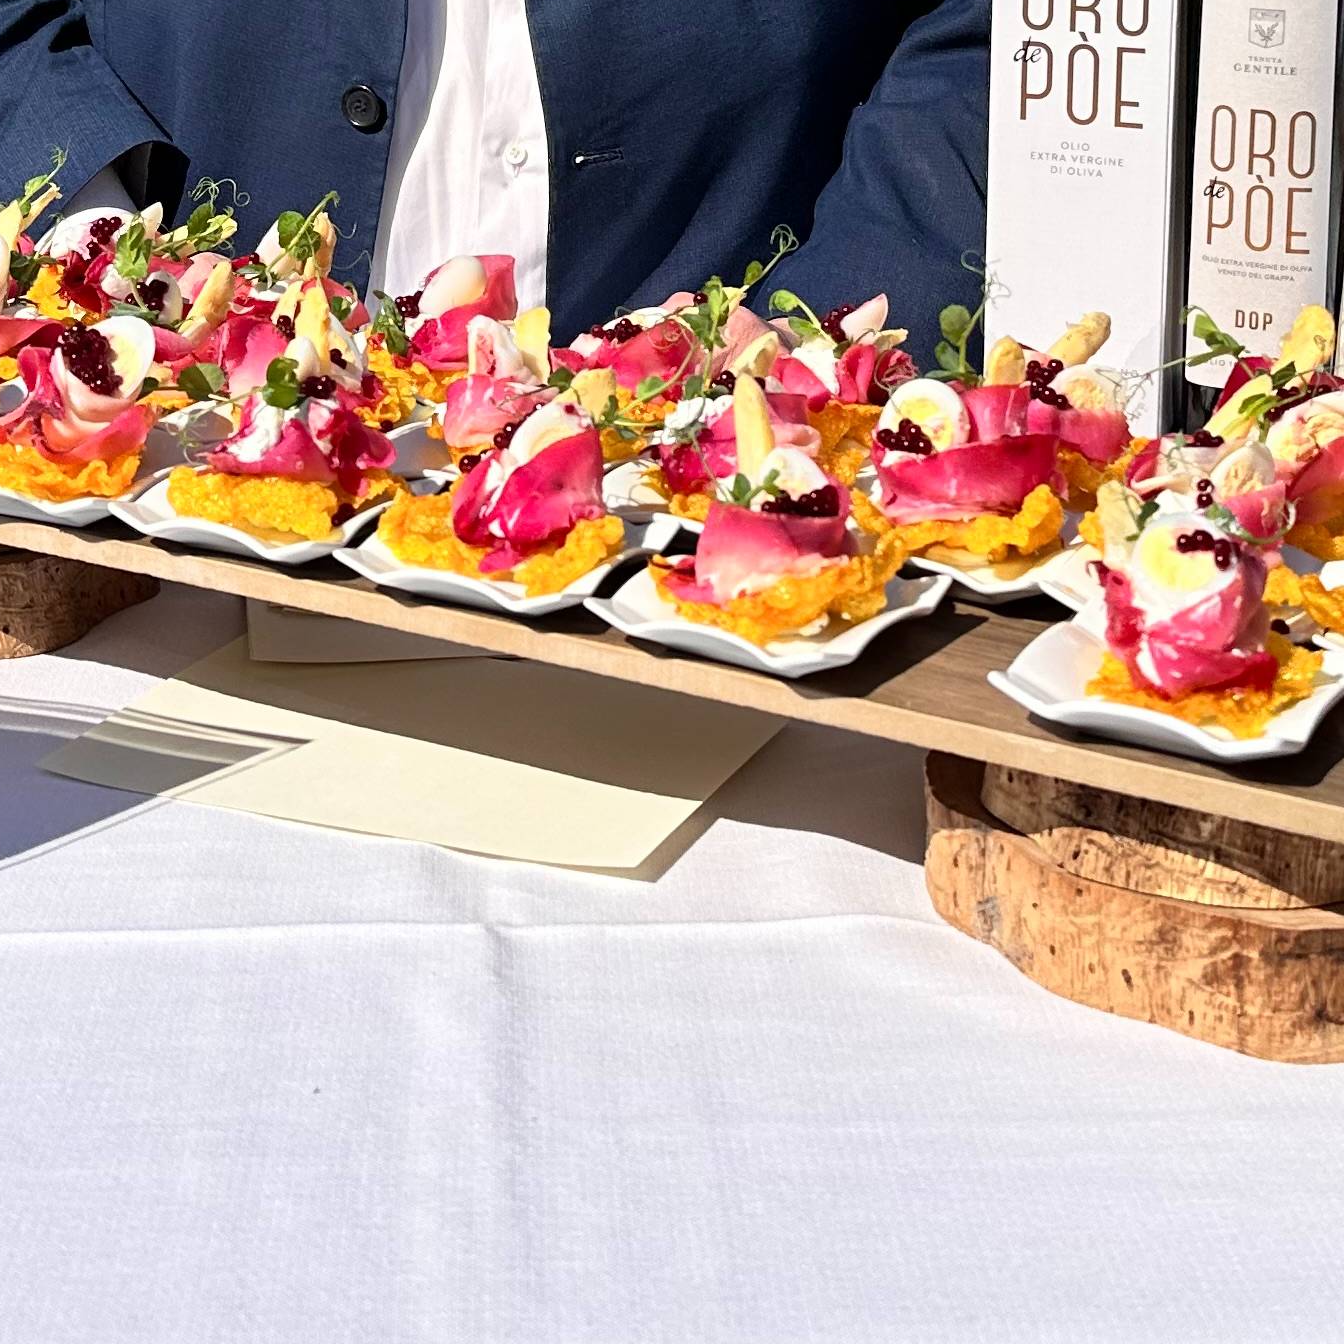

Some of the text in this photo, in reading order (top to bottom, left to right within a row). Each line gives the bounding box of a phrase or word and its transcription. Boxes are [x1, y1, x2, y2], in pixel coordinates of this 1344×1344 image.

[1013, 36, 1042, 63] de
[1233, 62, 1298, 76] GENTILE
[1248, 55, 1283, 64] TENUTA
[1020, 31, 1146, 129] PÒE
[1060, 141, 1090, 152] OLIO
[1210, 104, 1317, 179] ORO
[1030, 151, 1124, 168] EXTRA VERGINE
[1050, 165, 1103, 178] DI OLIVA
[1203, 175, 1226, 199] de
[1206, 174, 1313, 255] PÒE
[1202, 254, 1219, 264] OLIO
[1220, 258, 1244, 267] EXTRA
[1245, 260, 1278, 271] VERGINE
[1290, 265, 1313, 273] OLIVA
[1217, 268, 1247, 277] VENETO
[1264, 273, 1295, 282] GRAPPA
[1235, 309, 1273, 331] DOP
